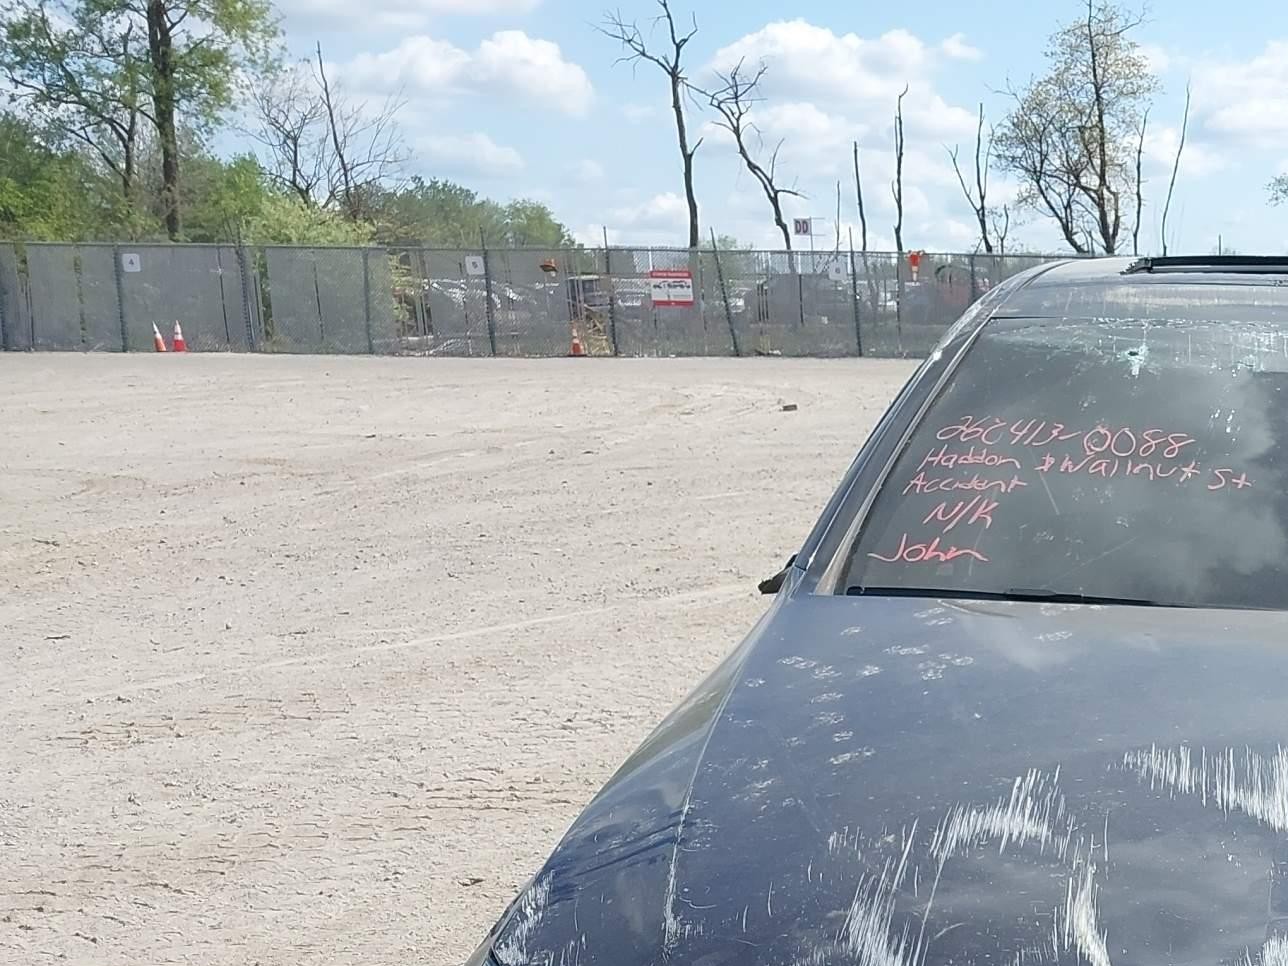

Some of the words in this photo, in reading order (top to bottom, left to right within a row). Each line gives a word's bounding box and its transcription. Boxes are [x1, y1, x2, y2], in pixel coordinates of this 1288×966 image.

[916, 443, 1022, 473] Haddon
[902, 470, 1028, 495] Accident
[867, 532, 990, 562] John
